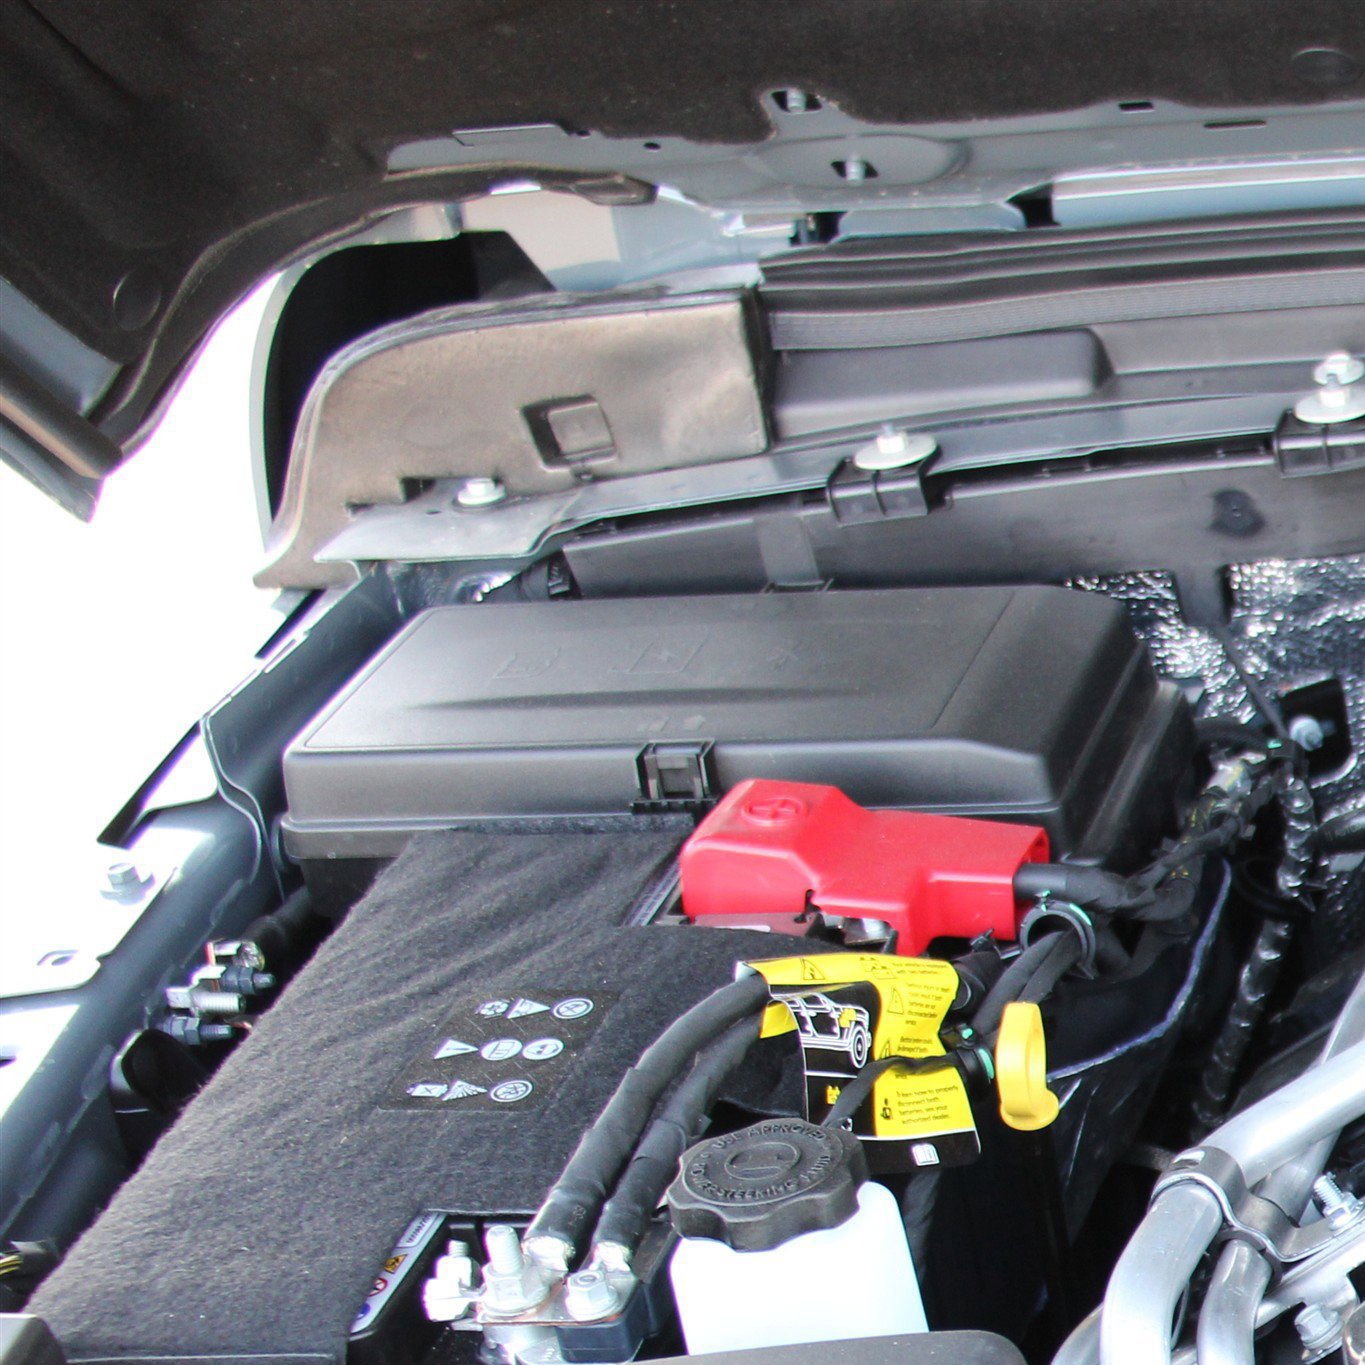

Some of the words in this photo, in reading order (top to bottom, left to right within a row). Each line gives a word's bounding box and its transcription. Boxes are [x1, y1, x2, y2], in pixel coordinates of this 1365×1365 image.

[711, 1133, 742, 1150] USE
[748, 1124, 827, 1142] APPROVED
[716, 1180, 796, 1200] STEERING
